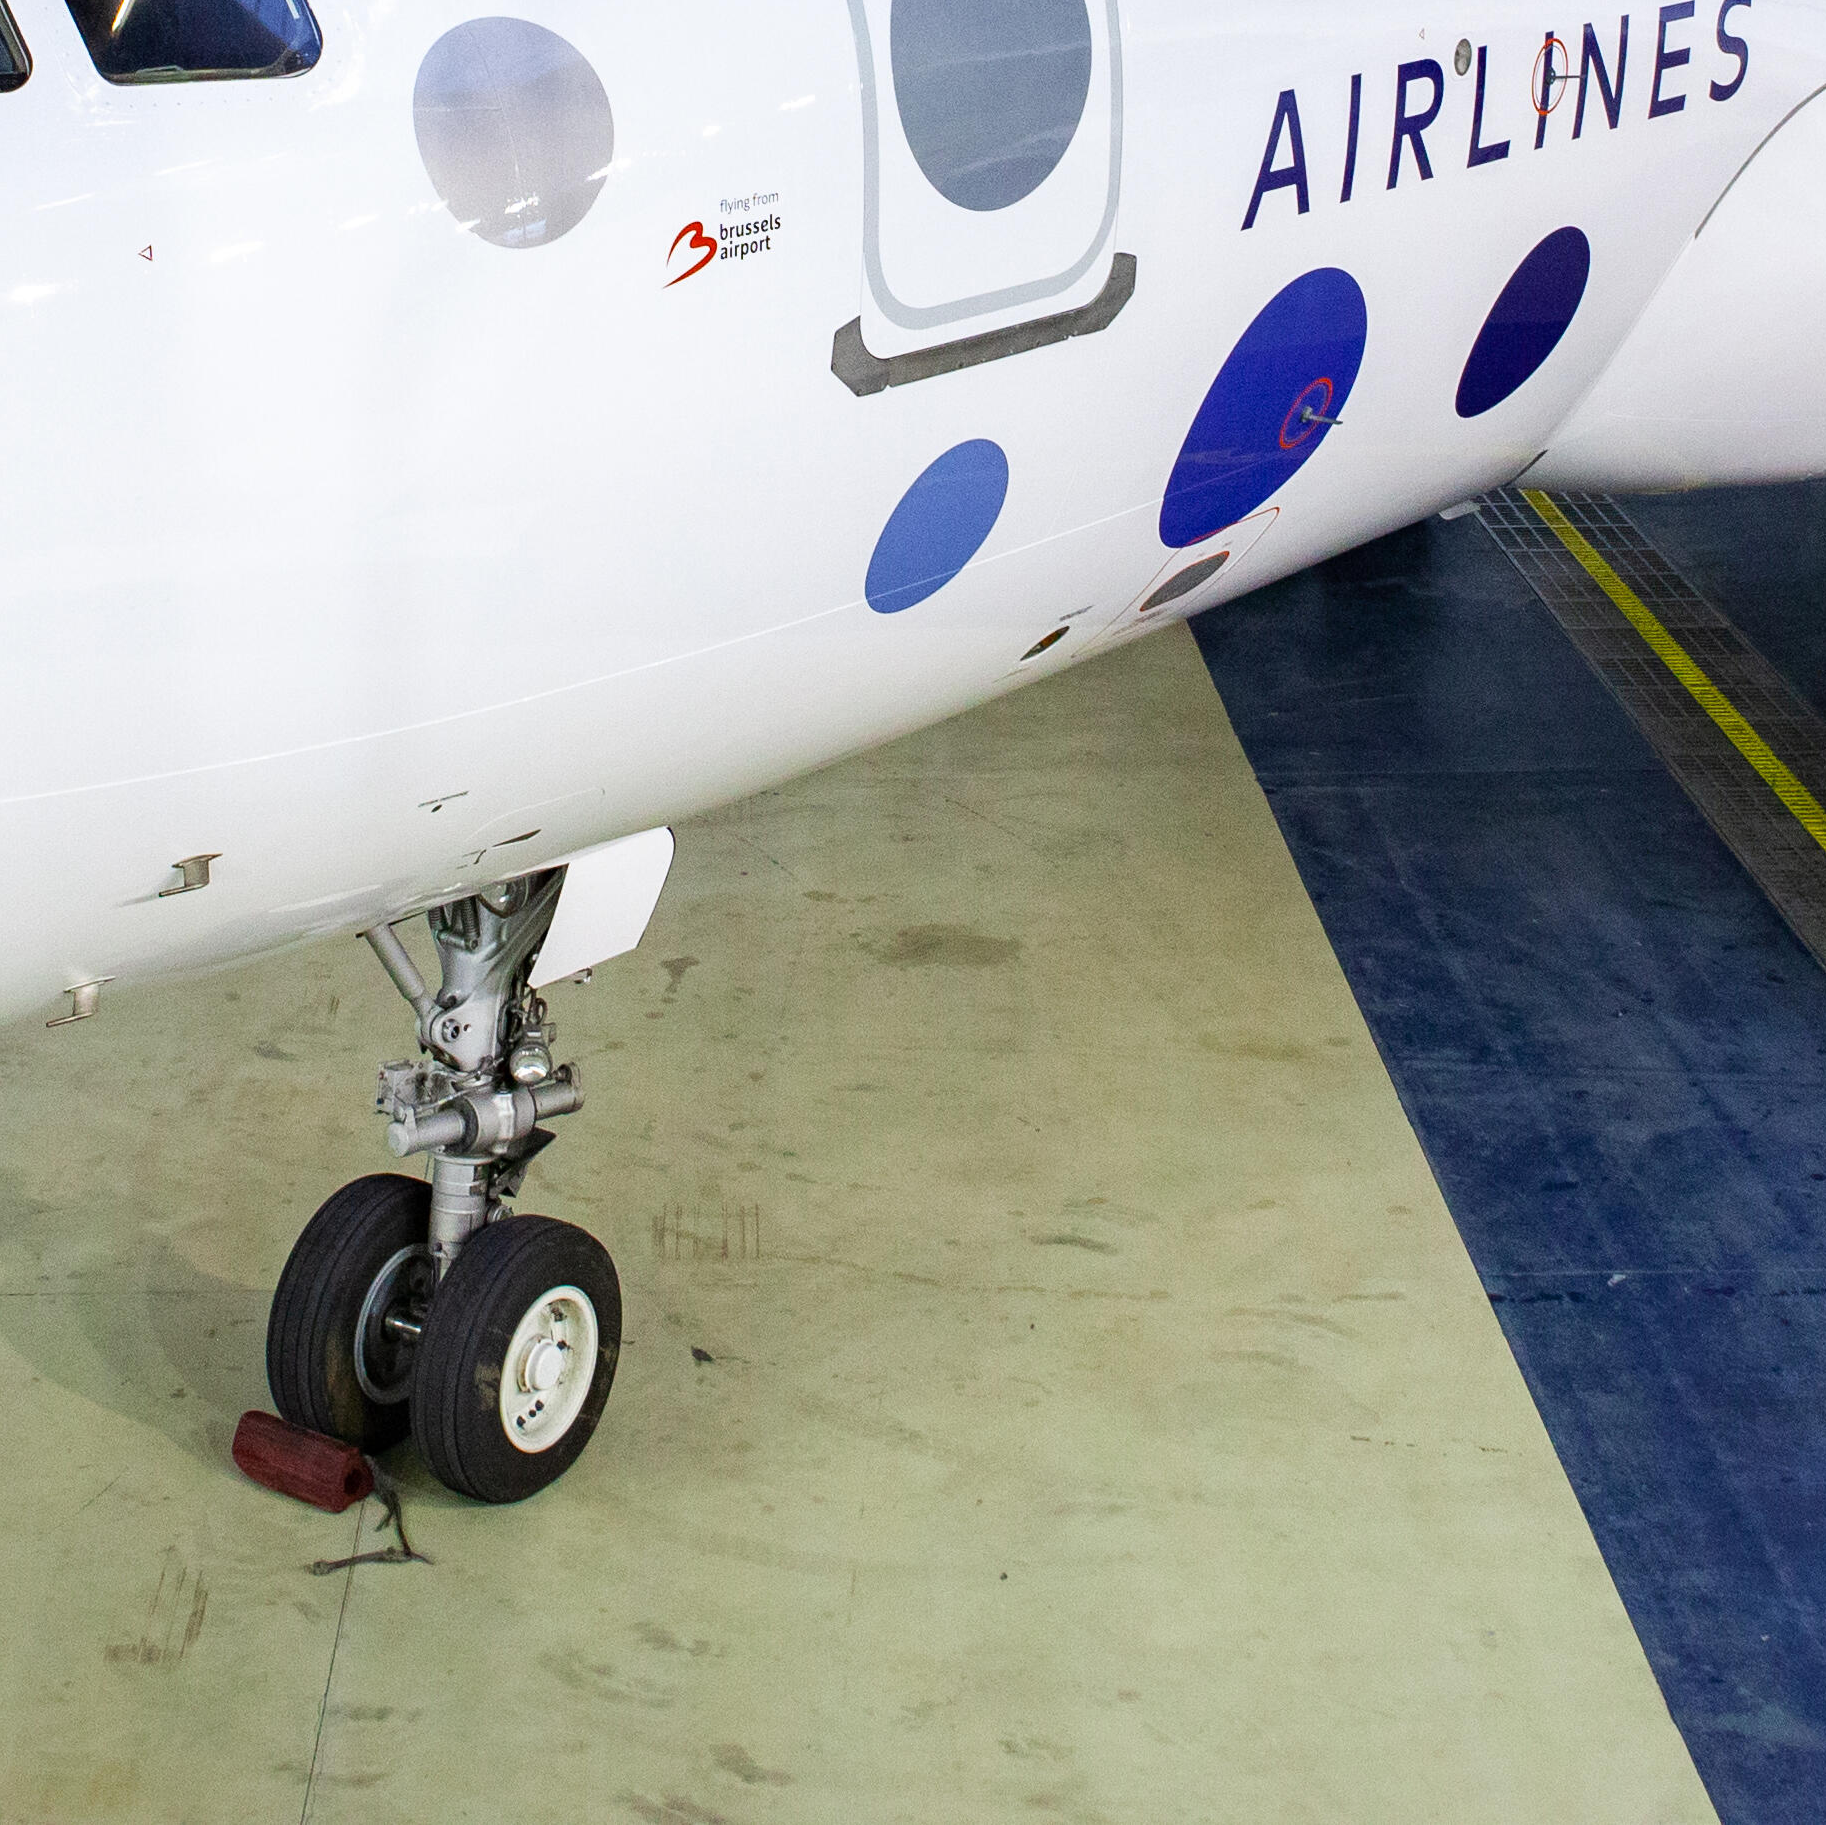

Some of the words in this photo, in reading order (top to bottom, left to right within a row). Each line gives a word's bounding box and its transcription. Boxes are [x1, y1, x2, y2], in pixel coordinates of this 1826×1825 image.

[720, 198, 750, 214] flying
[752, 192, 779, 207] from
[720, 214, 781, 240] brussels
[720, 235, 771, 260] airport
